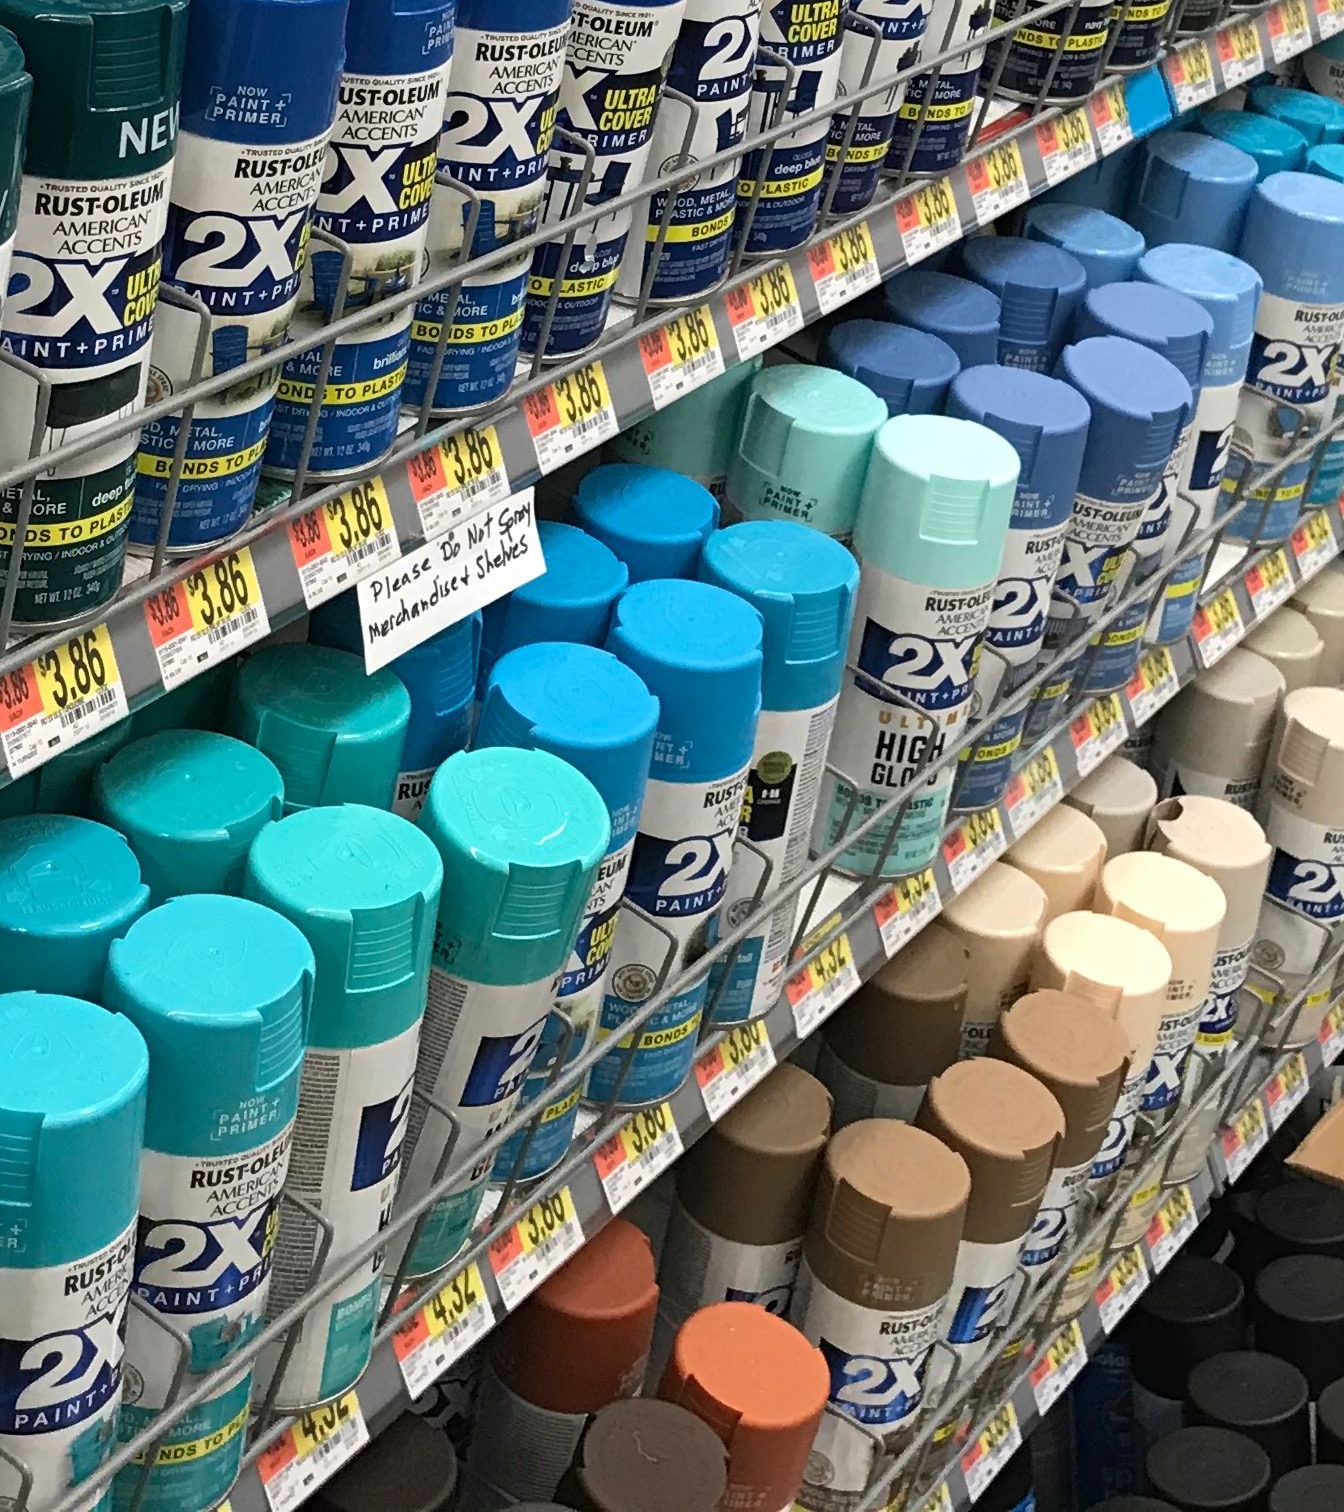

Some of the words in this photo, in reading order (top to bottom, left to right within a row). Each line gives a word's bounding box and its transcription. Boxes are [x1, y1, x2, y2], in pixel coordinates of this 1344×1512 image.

[787, 18, 838, 43] COVER
[214, 93, 270, 113] PAINT
[237, 86, 268, 98] NOW
[603, 83, 656, 111] ULTRA
[212, 107, 283, 127] PRIMER
[599, 107, 652, 132] COVER
[341, 122, 418, 141] ACCENTS
[34, 182, 165, 219] RUST-OLEUM
[51, 213, 147, 238] AMERICAN
[57, 232, 143, 257] ACCENTS
[175, 214, 304, 283] 2X
[370, 557, 433, 603] Please
[440, 541, 461, 562] Do
[468, 516, 494, 550] Not
[498, 502, 532, 542] Spray
[368, 574, 459, 644] Merchandise
[476, 535, 529, 580] Shelves
[643, 1029, 688, 1048] BONDS
